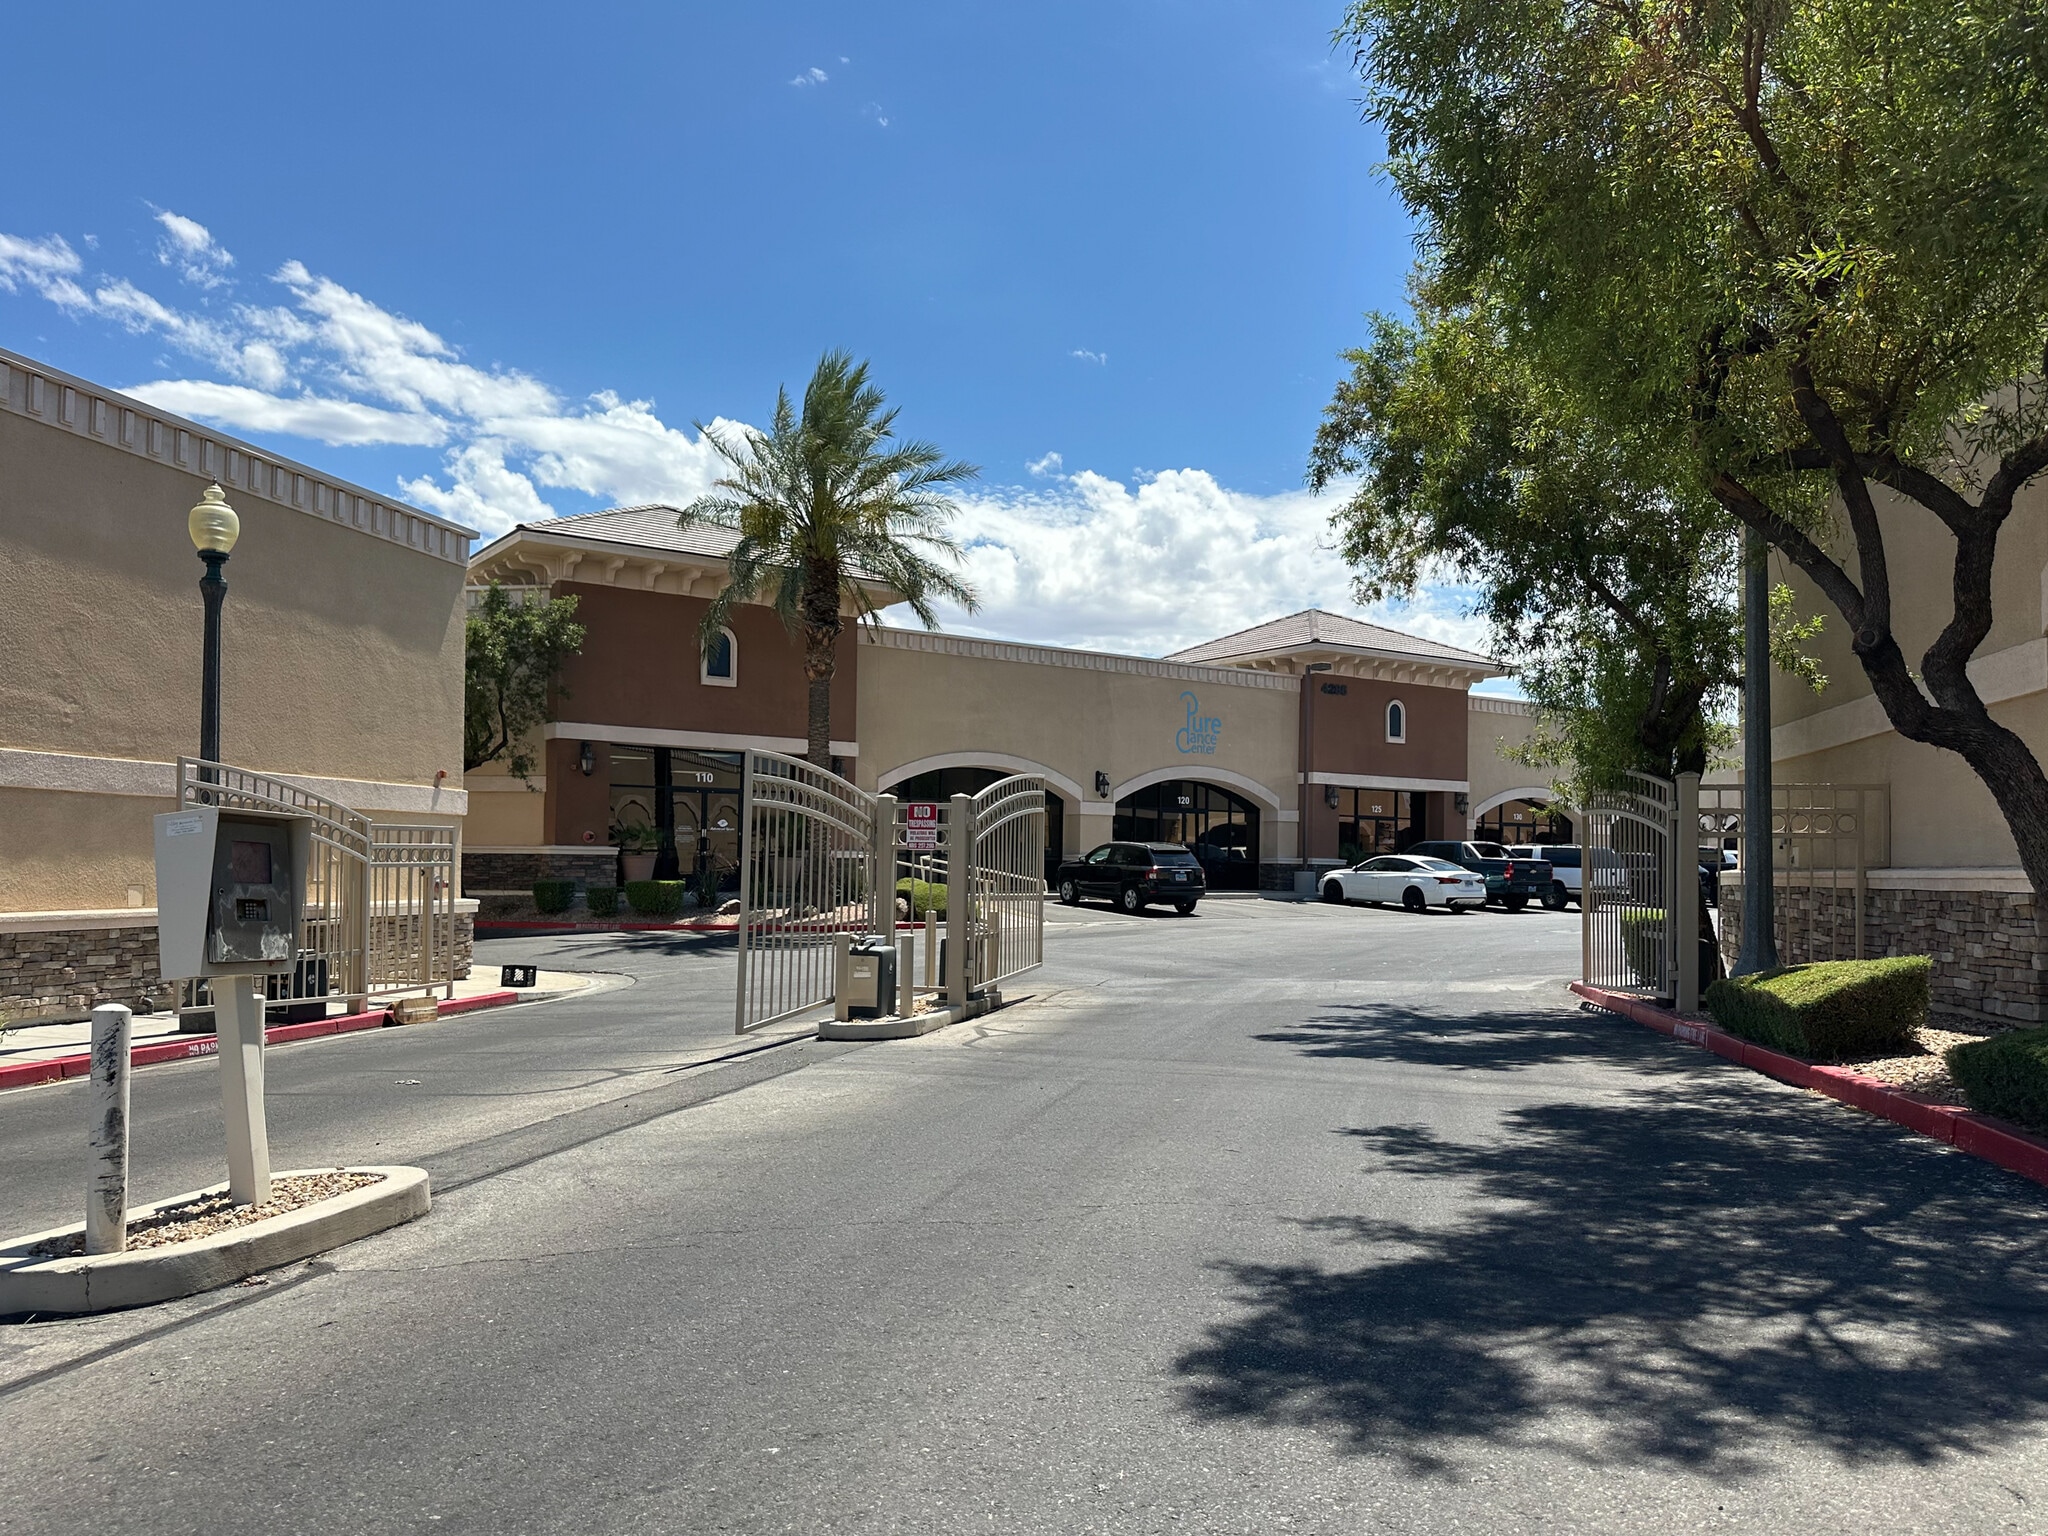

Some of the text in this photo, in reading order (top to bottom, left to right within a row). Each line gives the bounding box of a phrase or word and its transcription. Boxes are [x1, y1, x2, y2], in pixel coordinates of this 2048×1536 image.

[1180, 690, 1222, 738] Pure
[695, 773, 714, 783] 110
[1177, 796, 1190, 804] 120
[914, 806, 931, 818] NO
[1371, 805, 1382, 813] 125
[908, 819, 936, 828] TRESPASSING
[188, 1044, 199, 1056] NO
